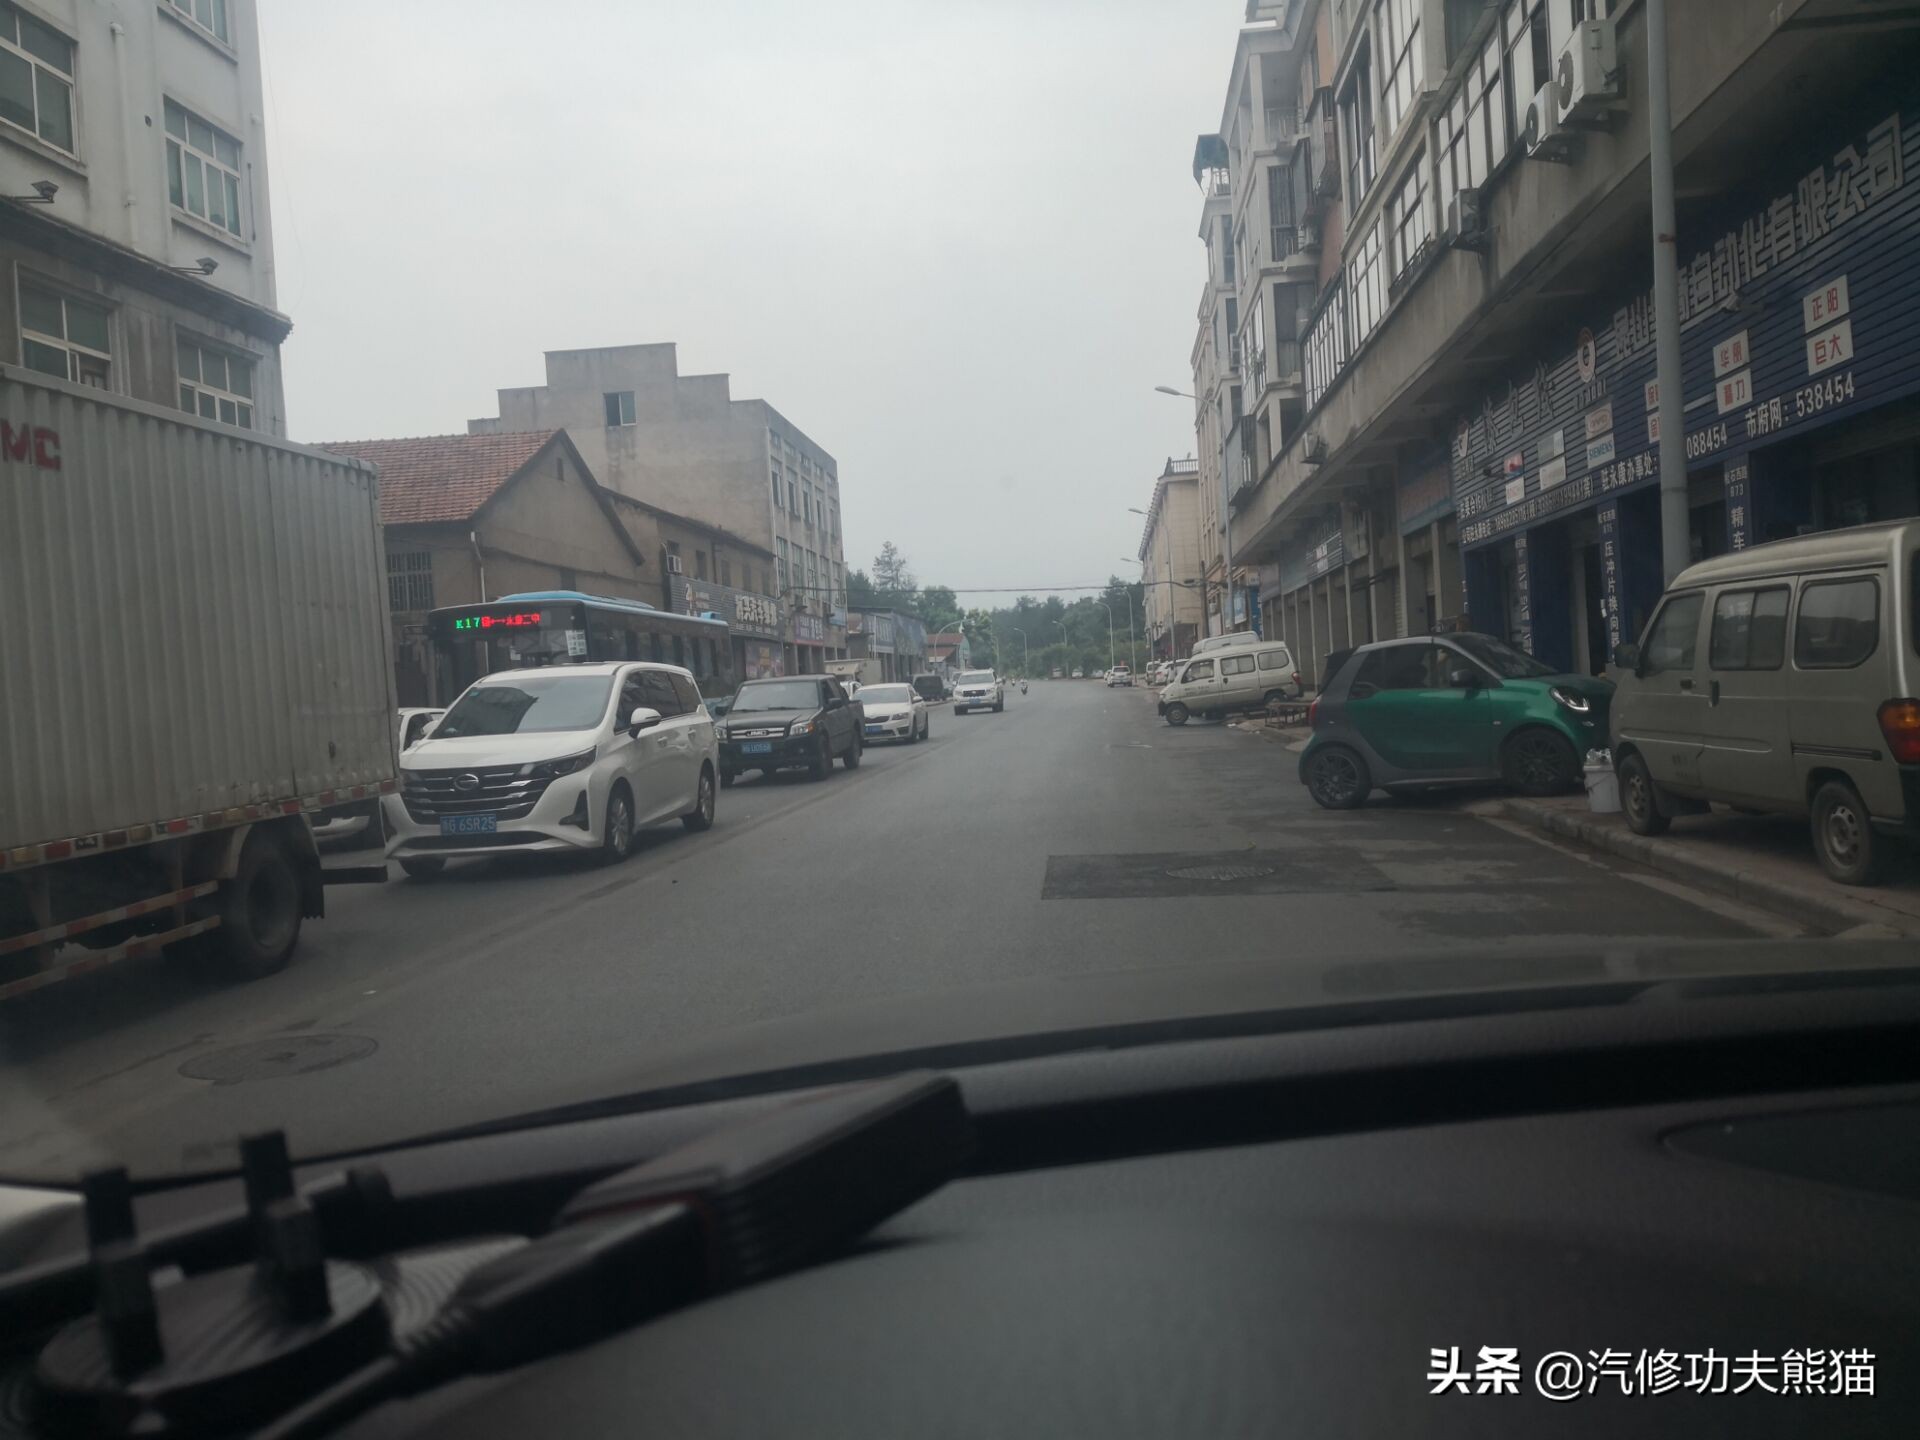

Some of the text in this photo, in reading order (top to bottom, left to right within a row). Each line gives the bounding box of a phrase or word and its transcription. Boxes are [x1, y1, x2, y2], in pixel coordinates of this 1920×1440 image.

[1613, 112, 1904, 358] 昆山自动化有限公司
[1811, 287, 1839, 322] 正阳
[1814, 333, 1843, 366] 巨大
[1795, 371, 1855, 418] 538454
